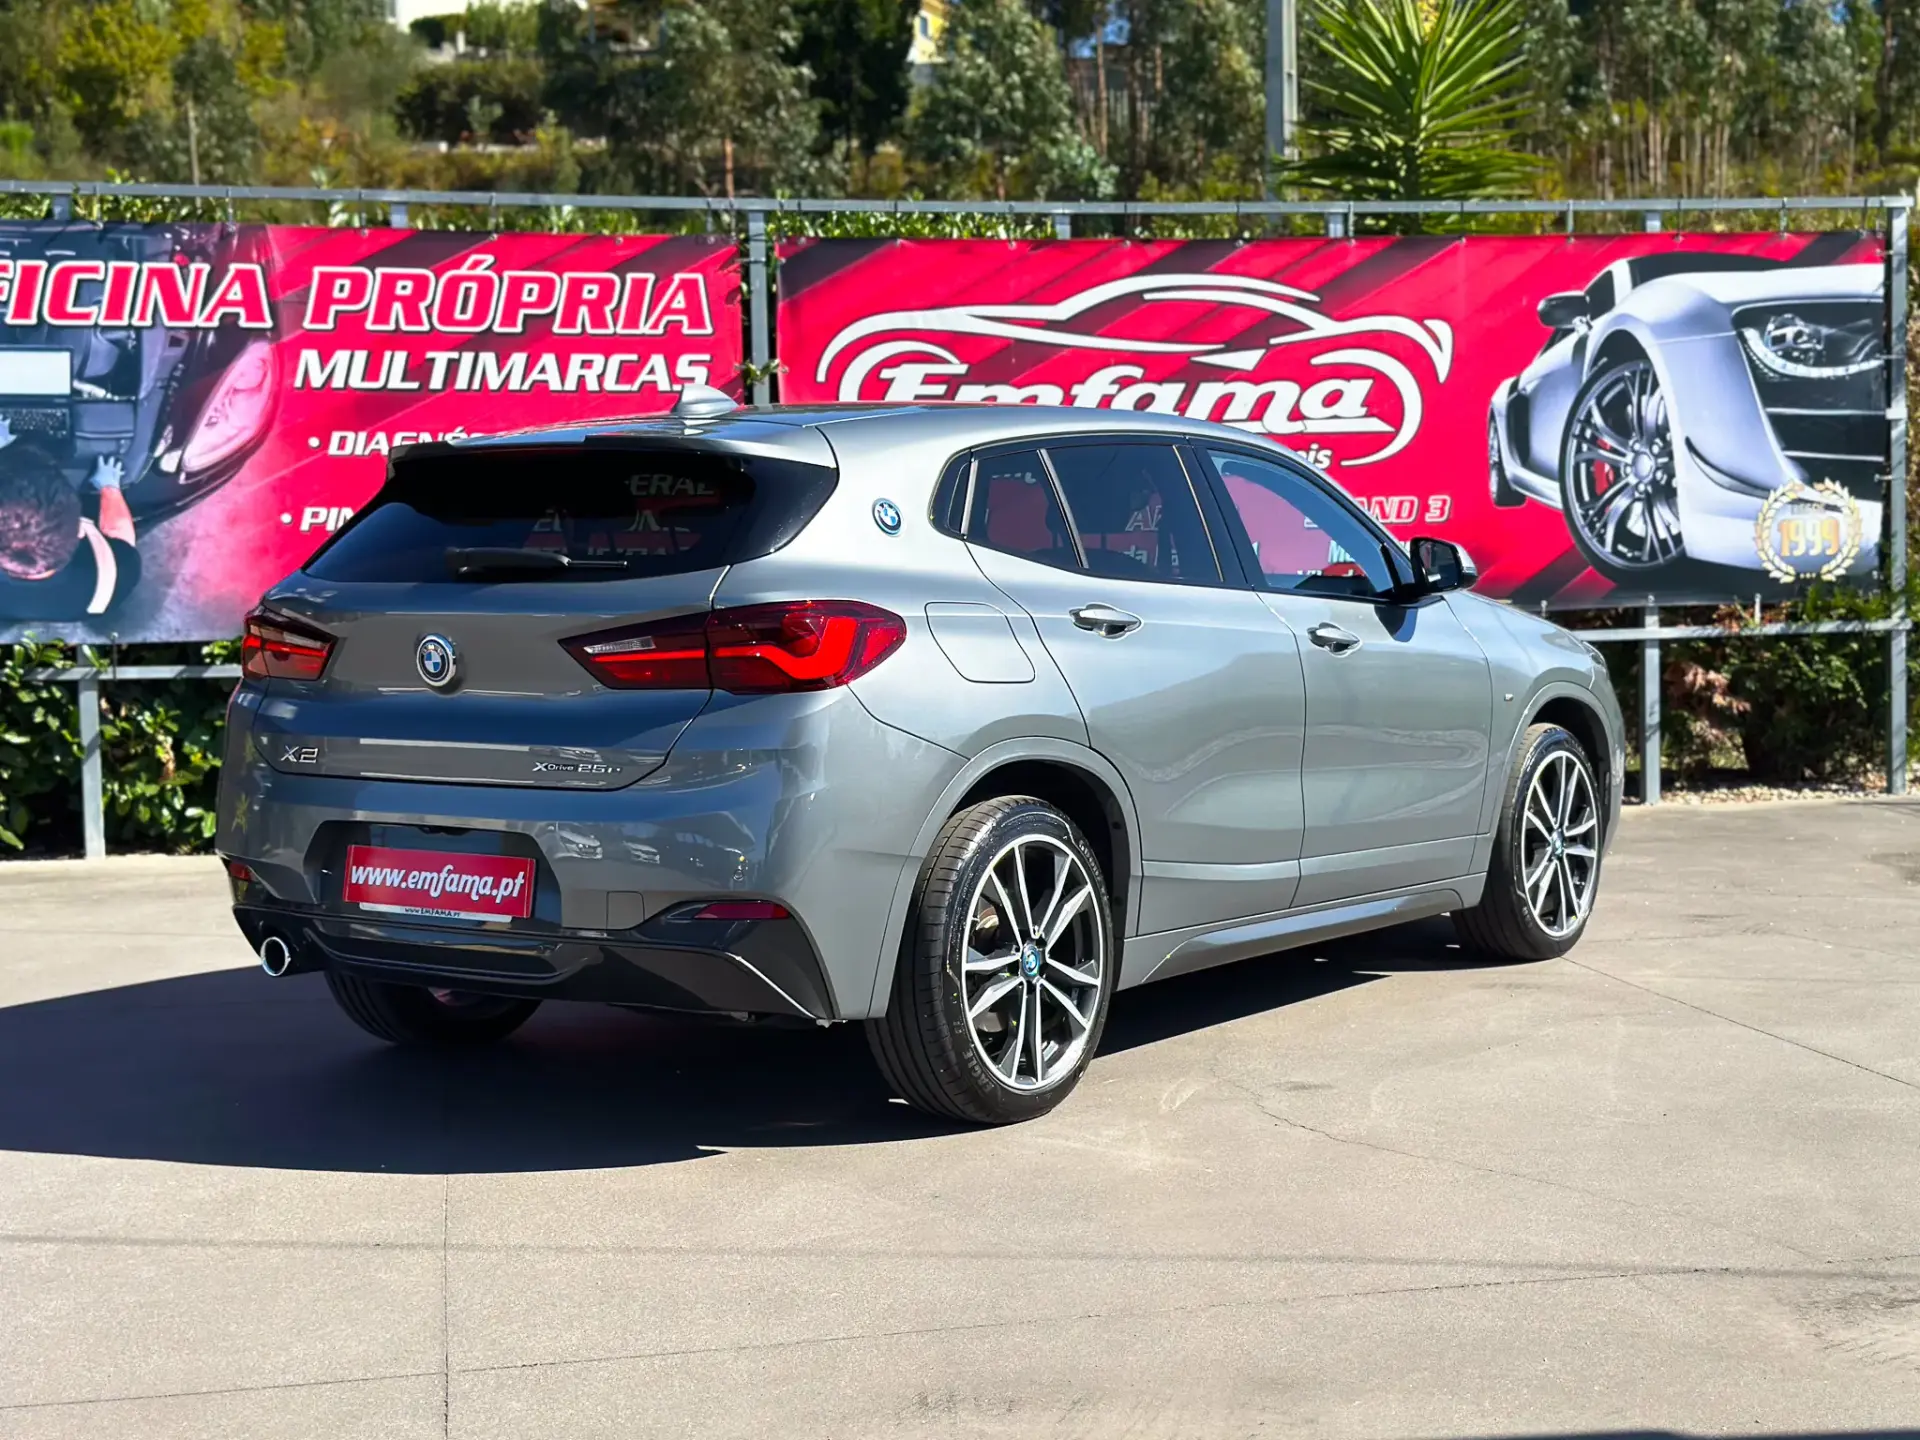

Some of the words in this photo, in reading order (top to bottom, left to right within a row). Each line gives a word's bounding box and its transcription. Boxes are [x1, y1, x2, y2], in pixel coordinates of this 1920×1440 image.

[303, 254, 714, 336] PRÓPRIA
[294, 349, 711, 392] MULTIMARCAS
[623, 473, 715, 496] ERAL
[1424, 495, 1452, 523] 3
[1777, 518, 1840, 557] 1999
[280, 745, 319, 764] X2
[351, 864, 525, 904] www.emfama.pt
